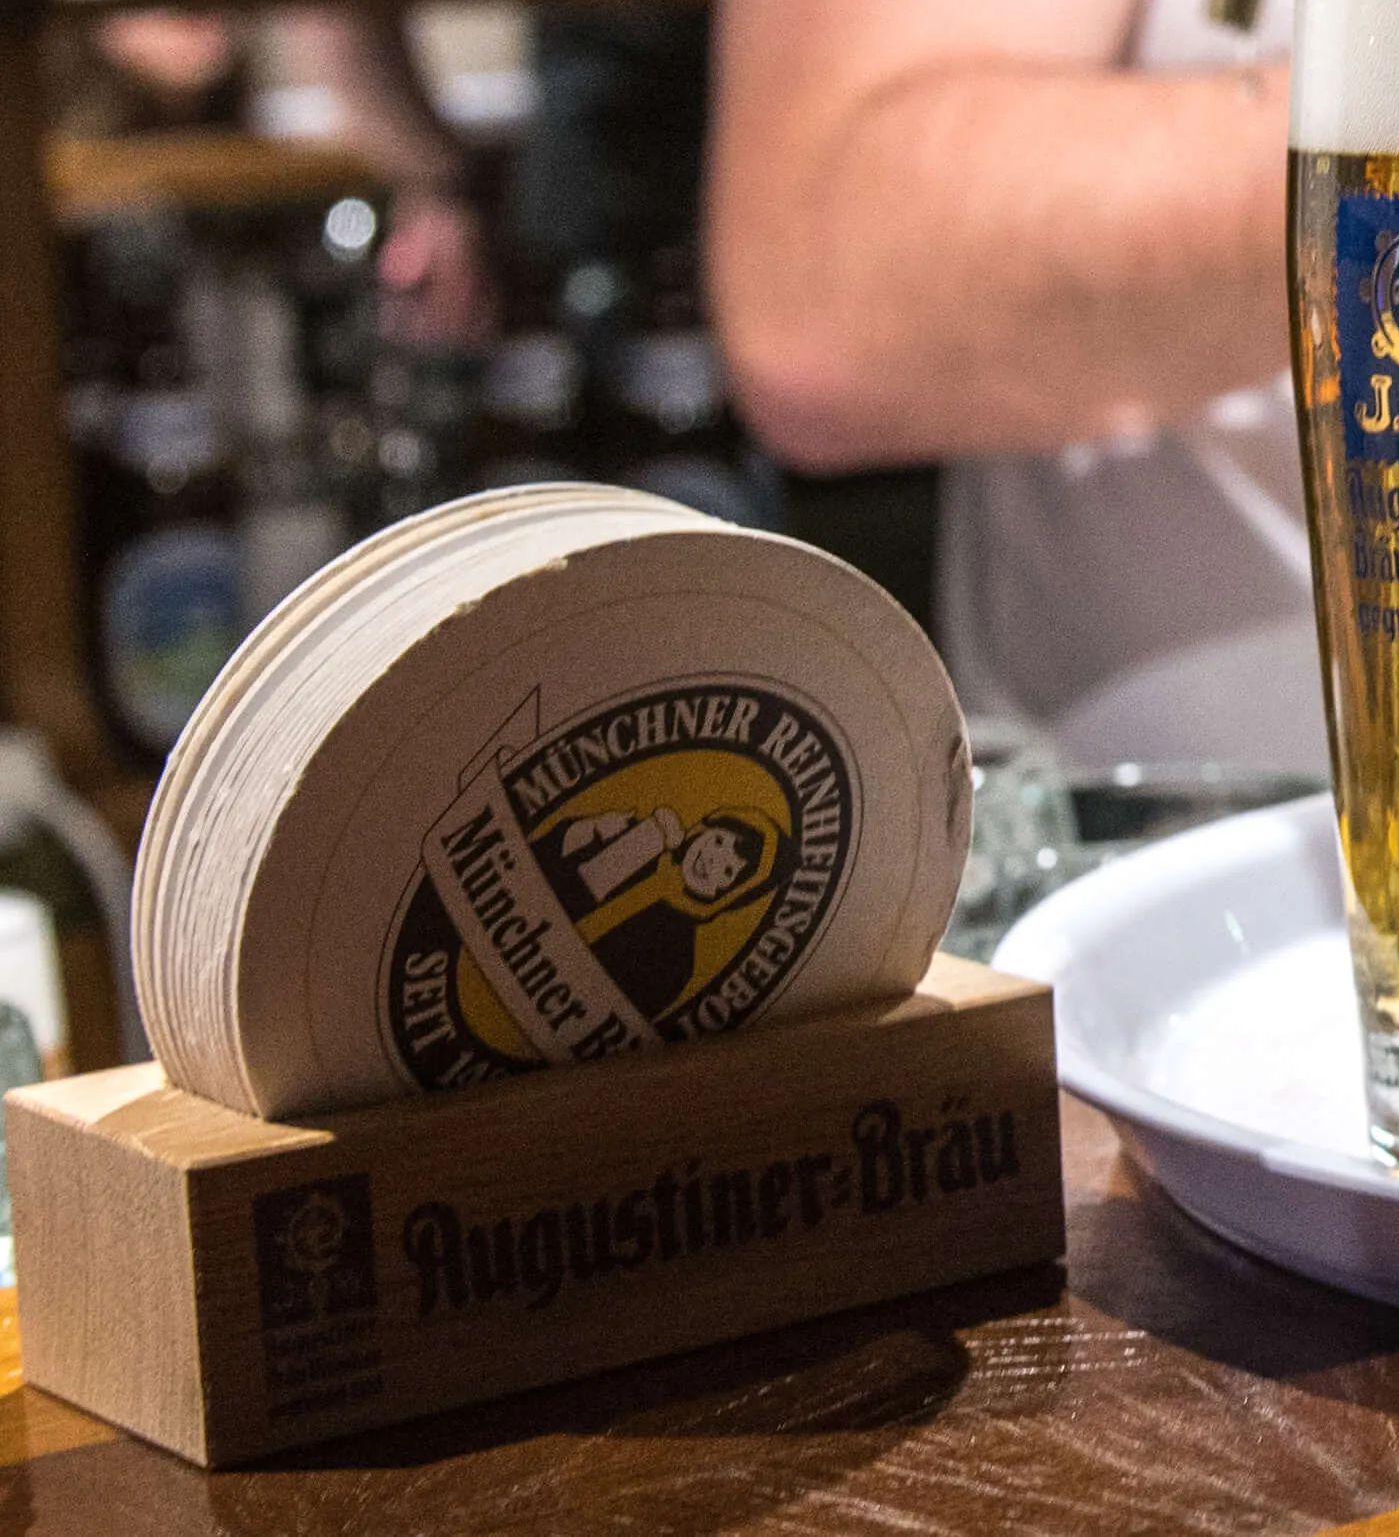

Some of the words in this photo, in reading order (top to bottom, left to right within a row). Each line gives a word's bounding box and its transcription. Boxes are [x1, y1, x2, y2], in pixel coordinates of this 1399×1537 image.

[508, 694, 760, 818] MÜNCHNER
[440, 804, 590, 1033] Münchner
[402, 950, 457, 1053] SEIT
